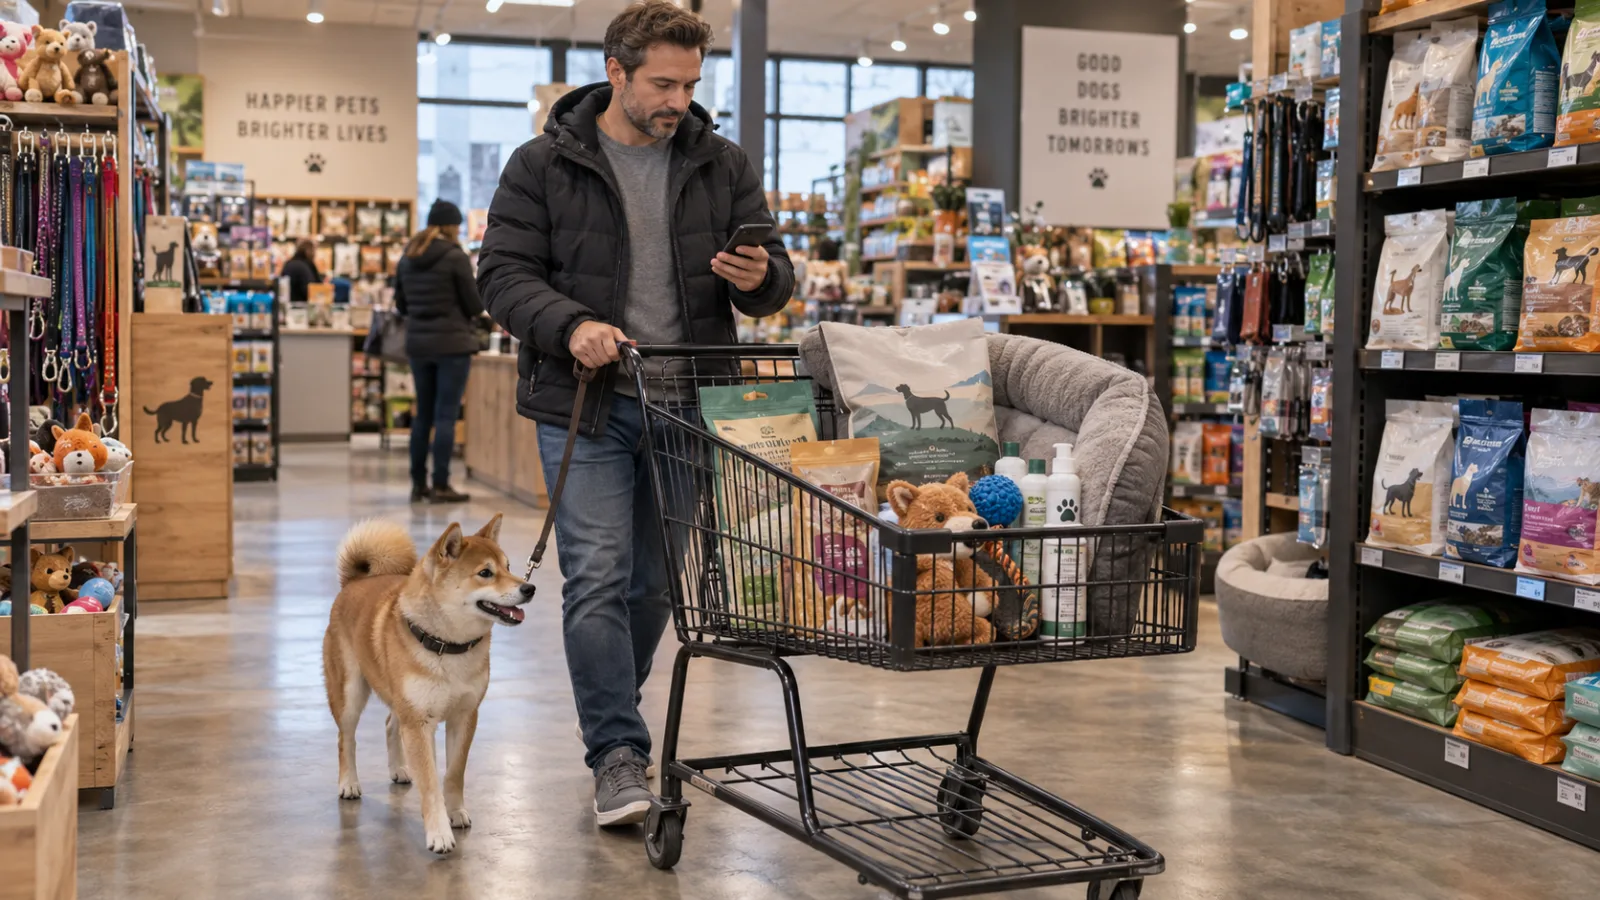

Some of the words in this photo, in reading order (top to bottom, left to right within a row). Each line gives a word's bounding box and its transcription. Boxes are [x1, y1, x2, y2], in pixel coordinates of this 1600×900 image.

[1077, 53, 1121, 72] GOOD
[1077, 81, 1120, 100] DOGS
[246, 93, 327, 112] HAPPIER
[335, 96, 379, 115] PETS
[1058, 108, 1140, 128] BRIGHTER
[237, 120, 329, 140] BRIGHTER
[337, 124, 387, 143] LIVES
[1047, 134, 1149, 156] TOMORROWS
